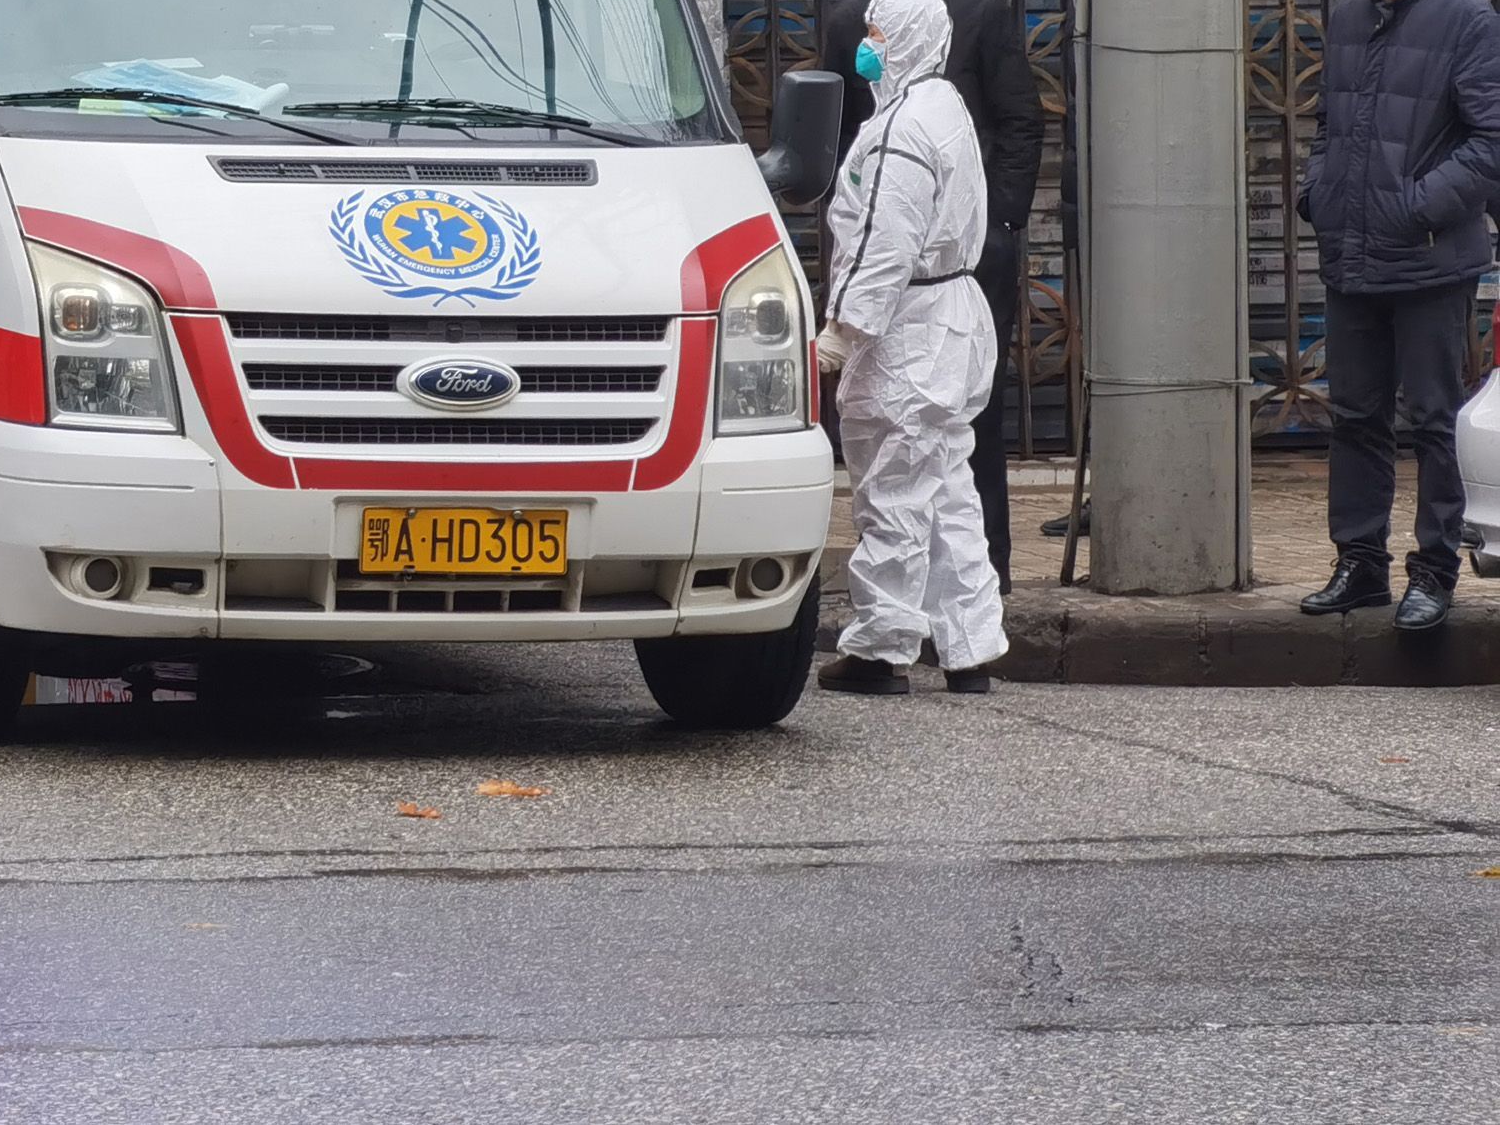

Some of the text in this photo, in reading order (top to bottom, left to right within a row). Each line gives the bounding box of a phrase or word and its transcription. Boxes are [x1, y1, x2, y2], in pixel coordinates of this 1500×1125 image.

[368, 188, 485, 220] 武汉市急救中心
[372, 234, 398, 259] WUHAN
[398, 257, 456, 275] EMERGENCY
[459, 257, 494, 275] MEDICAL
[435, 367, 493, 393] Ford
